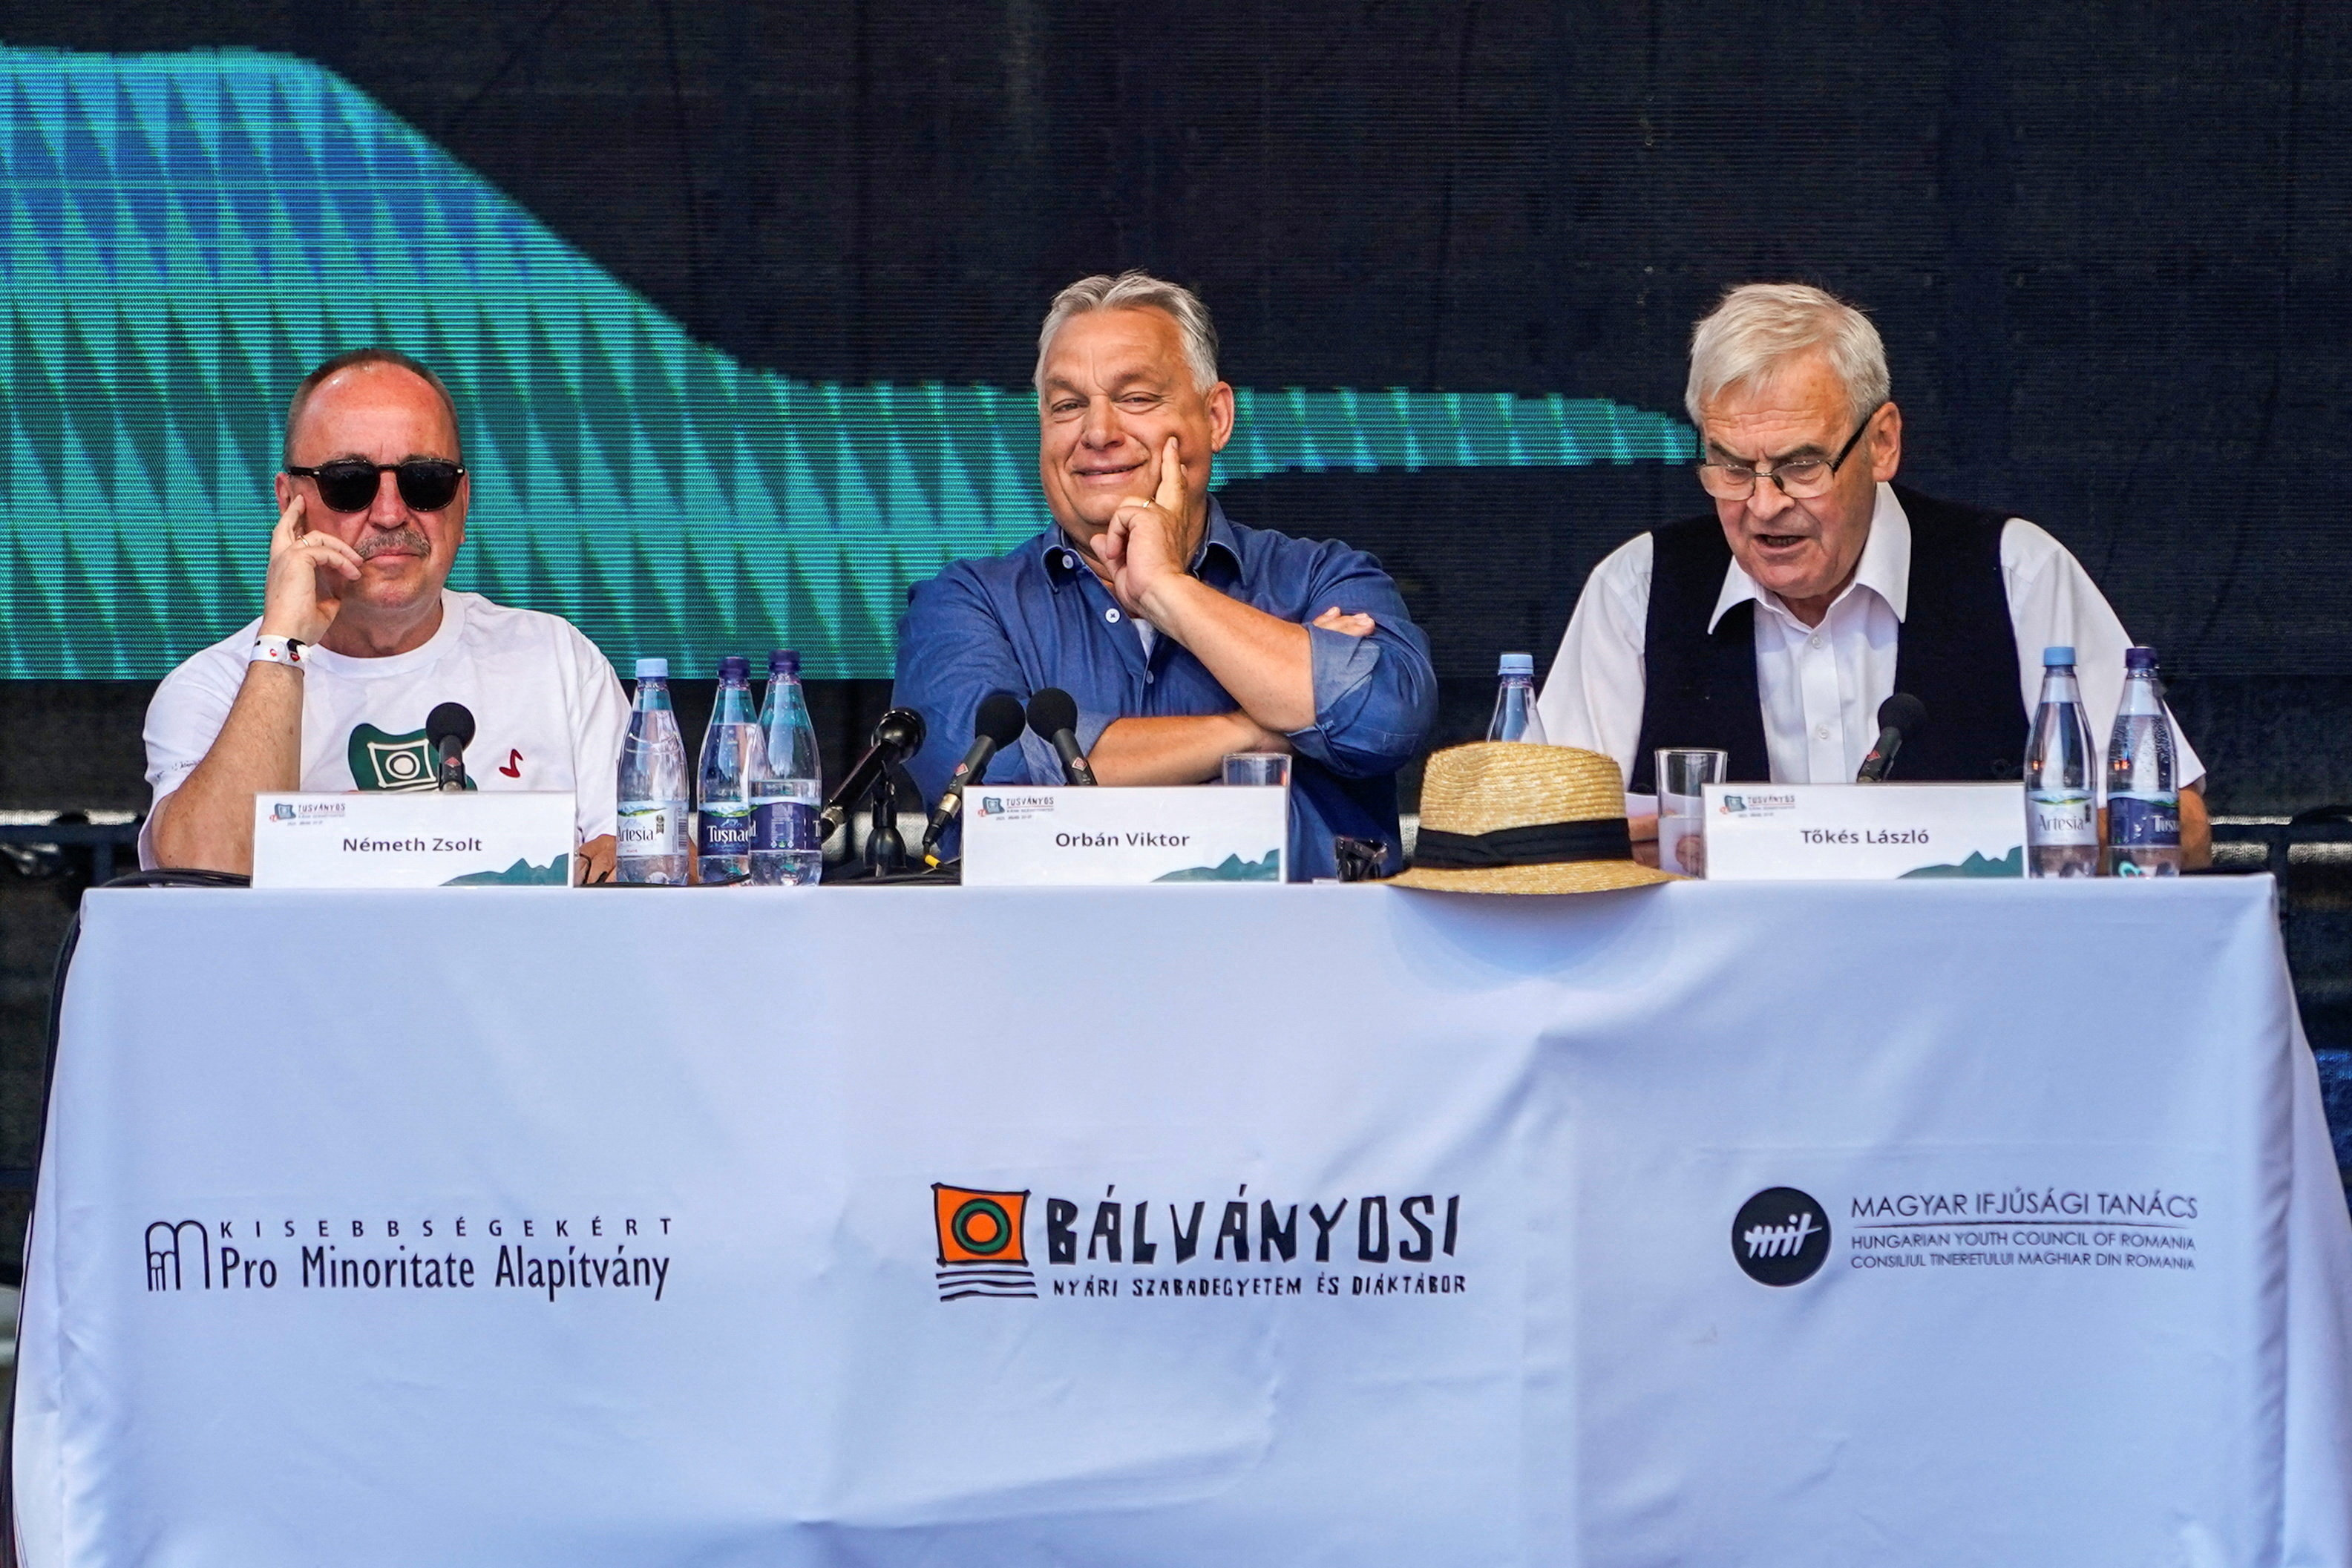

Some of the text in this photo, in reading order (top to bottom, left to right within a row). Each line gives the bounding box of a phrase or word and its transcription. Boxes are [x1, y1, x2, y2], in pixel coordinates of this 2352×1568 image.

[2038, 814, 2084, 831] Artesia
[344, 837, 482, 852] Németh Zsolt
[1055, 832, 1190, 847] Orbán Viktor
[1801, 829, 1929, 844] Tőkés László
[1851, 1194, 1968, 1218] MAGYAR
[2097, 1190, 2198, 1219] TANÁCS
[1046, 1184, 1461, 1266] BÁLVÁNYOSI
[1851, 1232, 2196, 1250] HUNGARIAN YOUTH COUNCIL OF ROMANIA
[1850, 1252, 2195, 1270] CONSILIUL TINERETULUI MAGHIAR DIN ROMANIA
[221, 1244, 670, 1303] Pro Minoritate Alapítvány
[1053, 1272, 1466, 1298] NYÁRI SZABADEGYETEM ÉS DIÁKTÁBOR
